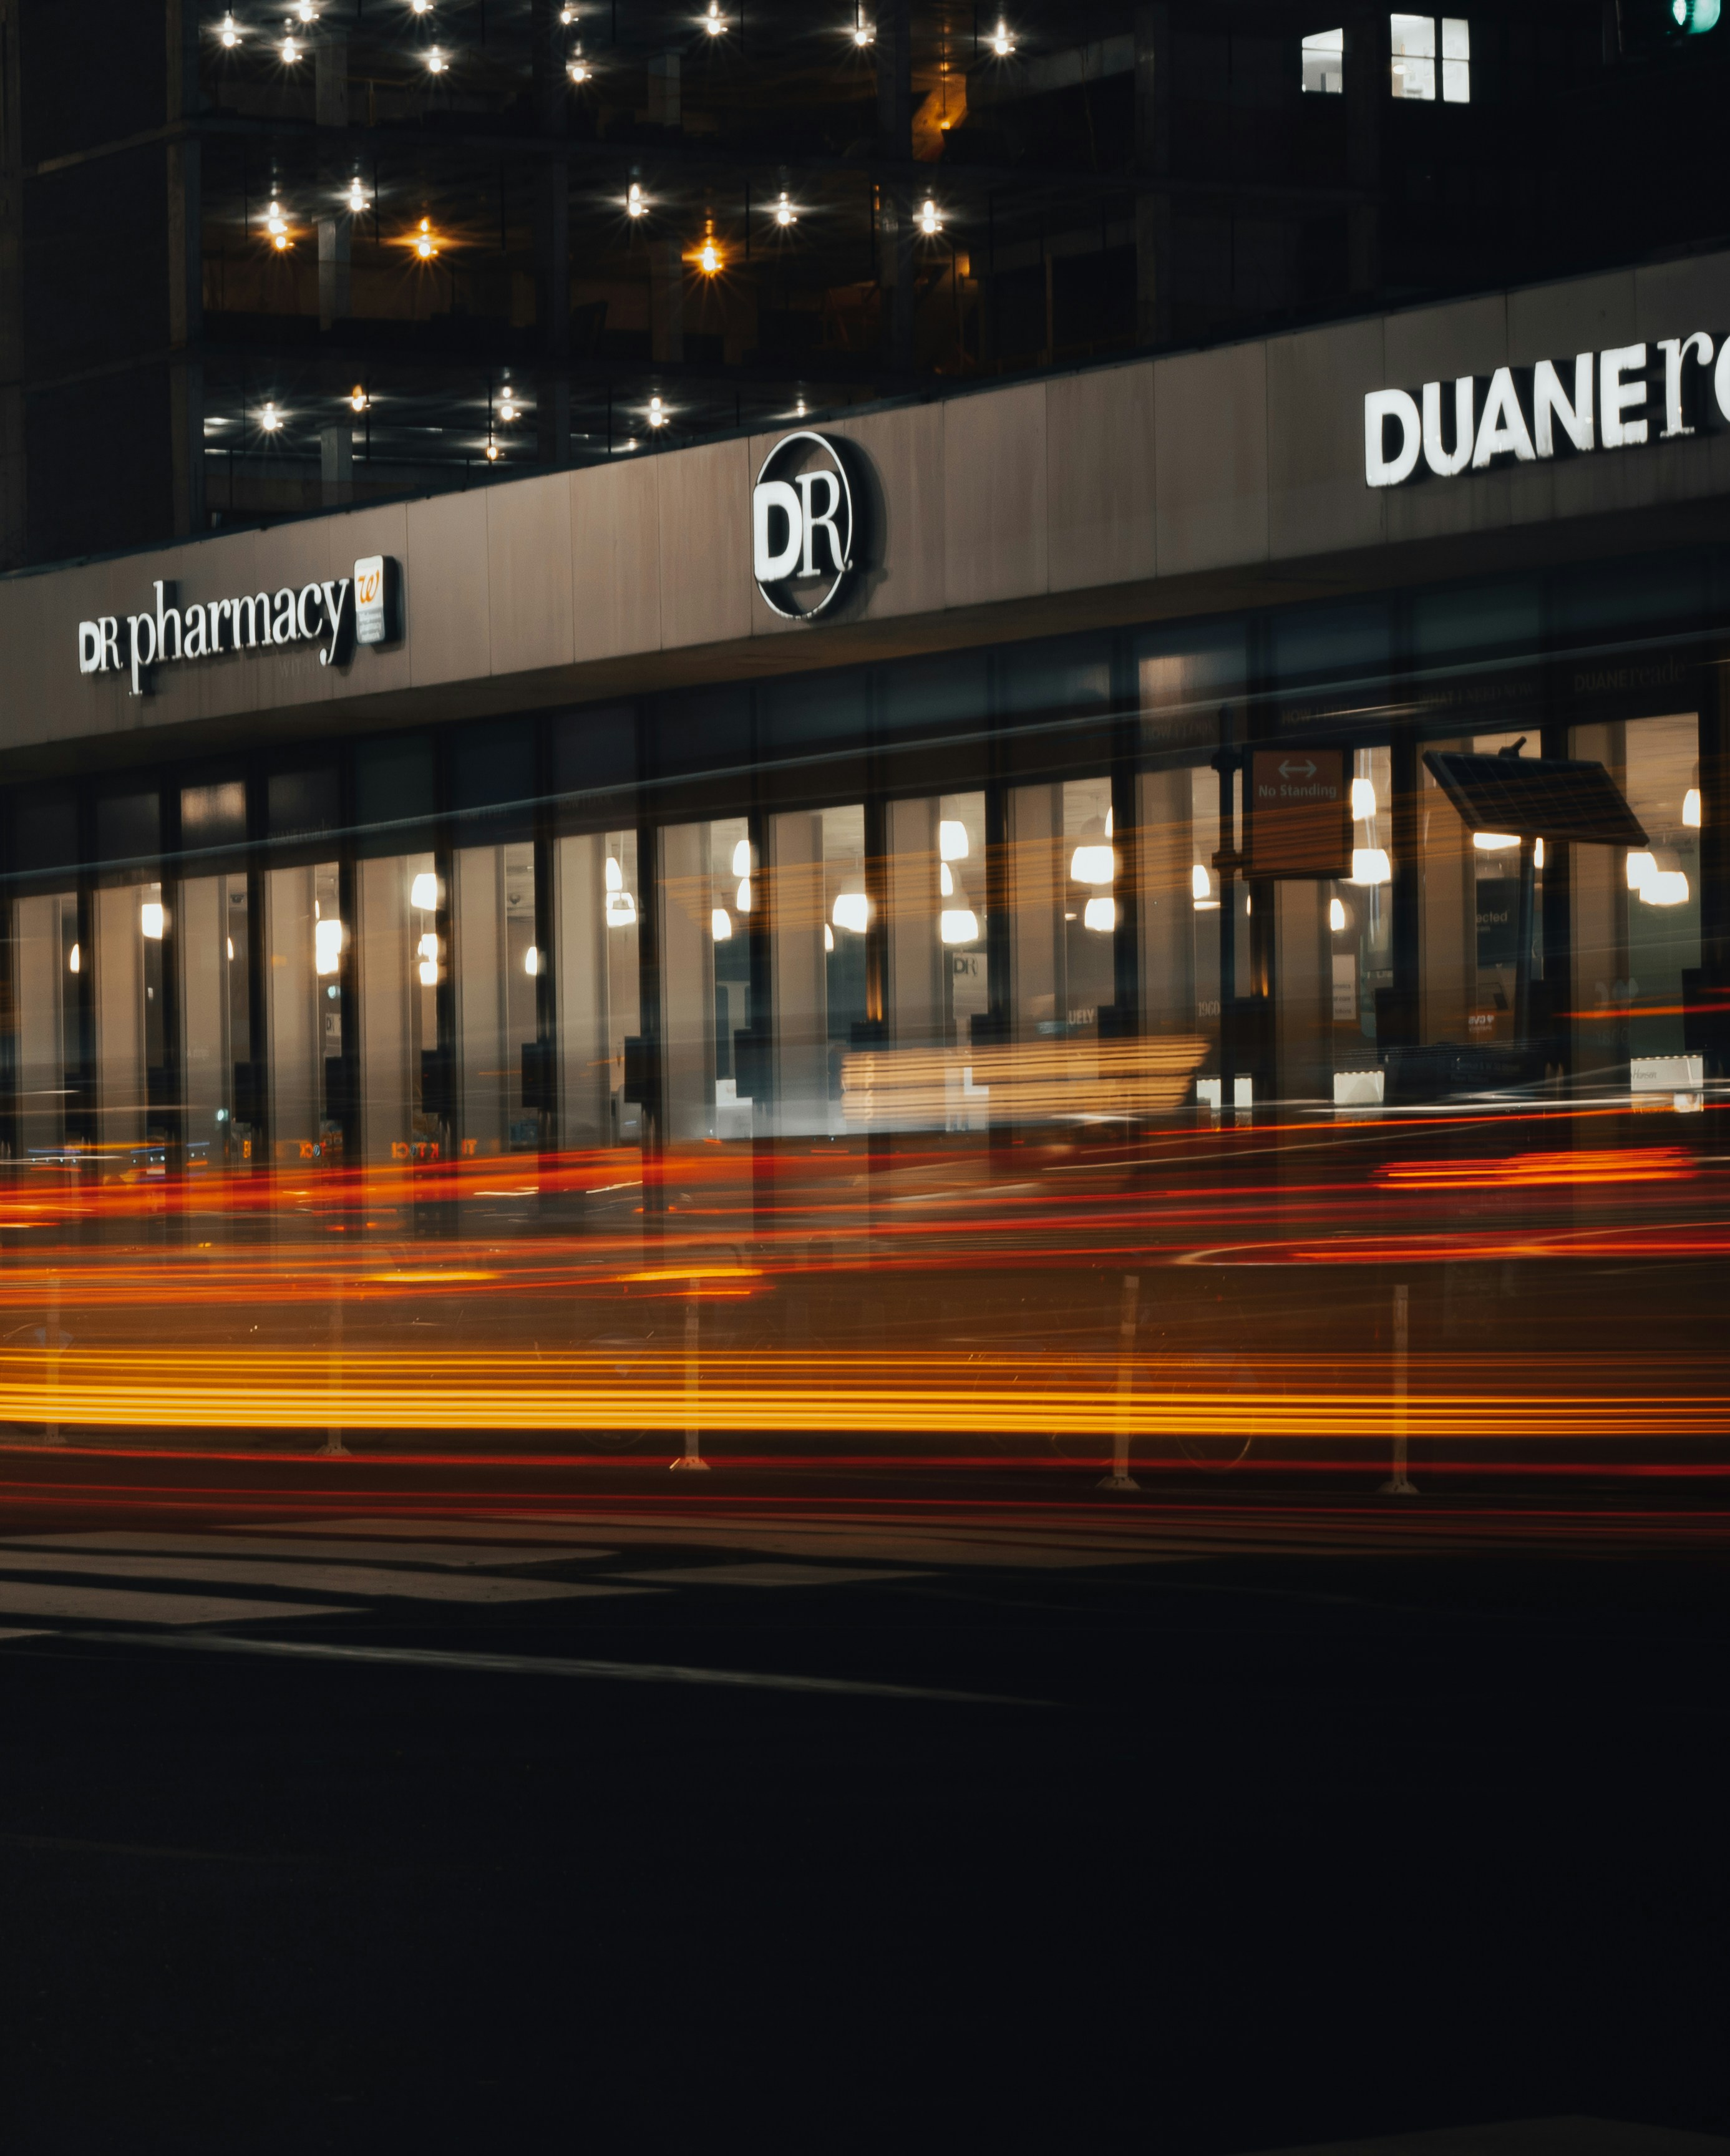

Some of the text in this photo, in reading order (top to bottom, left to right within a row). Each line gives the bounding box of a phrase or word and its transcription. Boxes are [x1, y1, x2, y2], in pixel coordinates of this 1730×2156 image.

[753, 470, 853, 582] DR
[79, 579, 349, 696] DR pharmacy
[1258, 780, 1337, 799] No Standing
